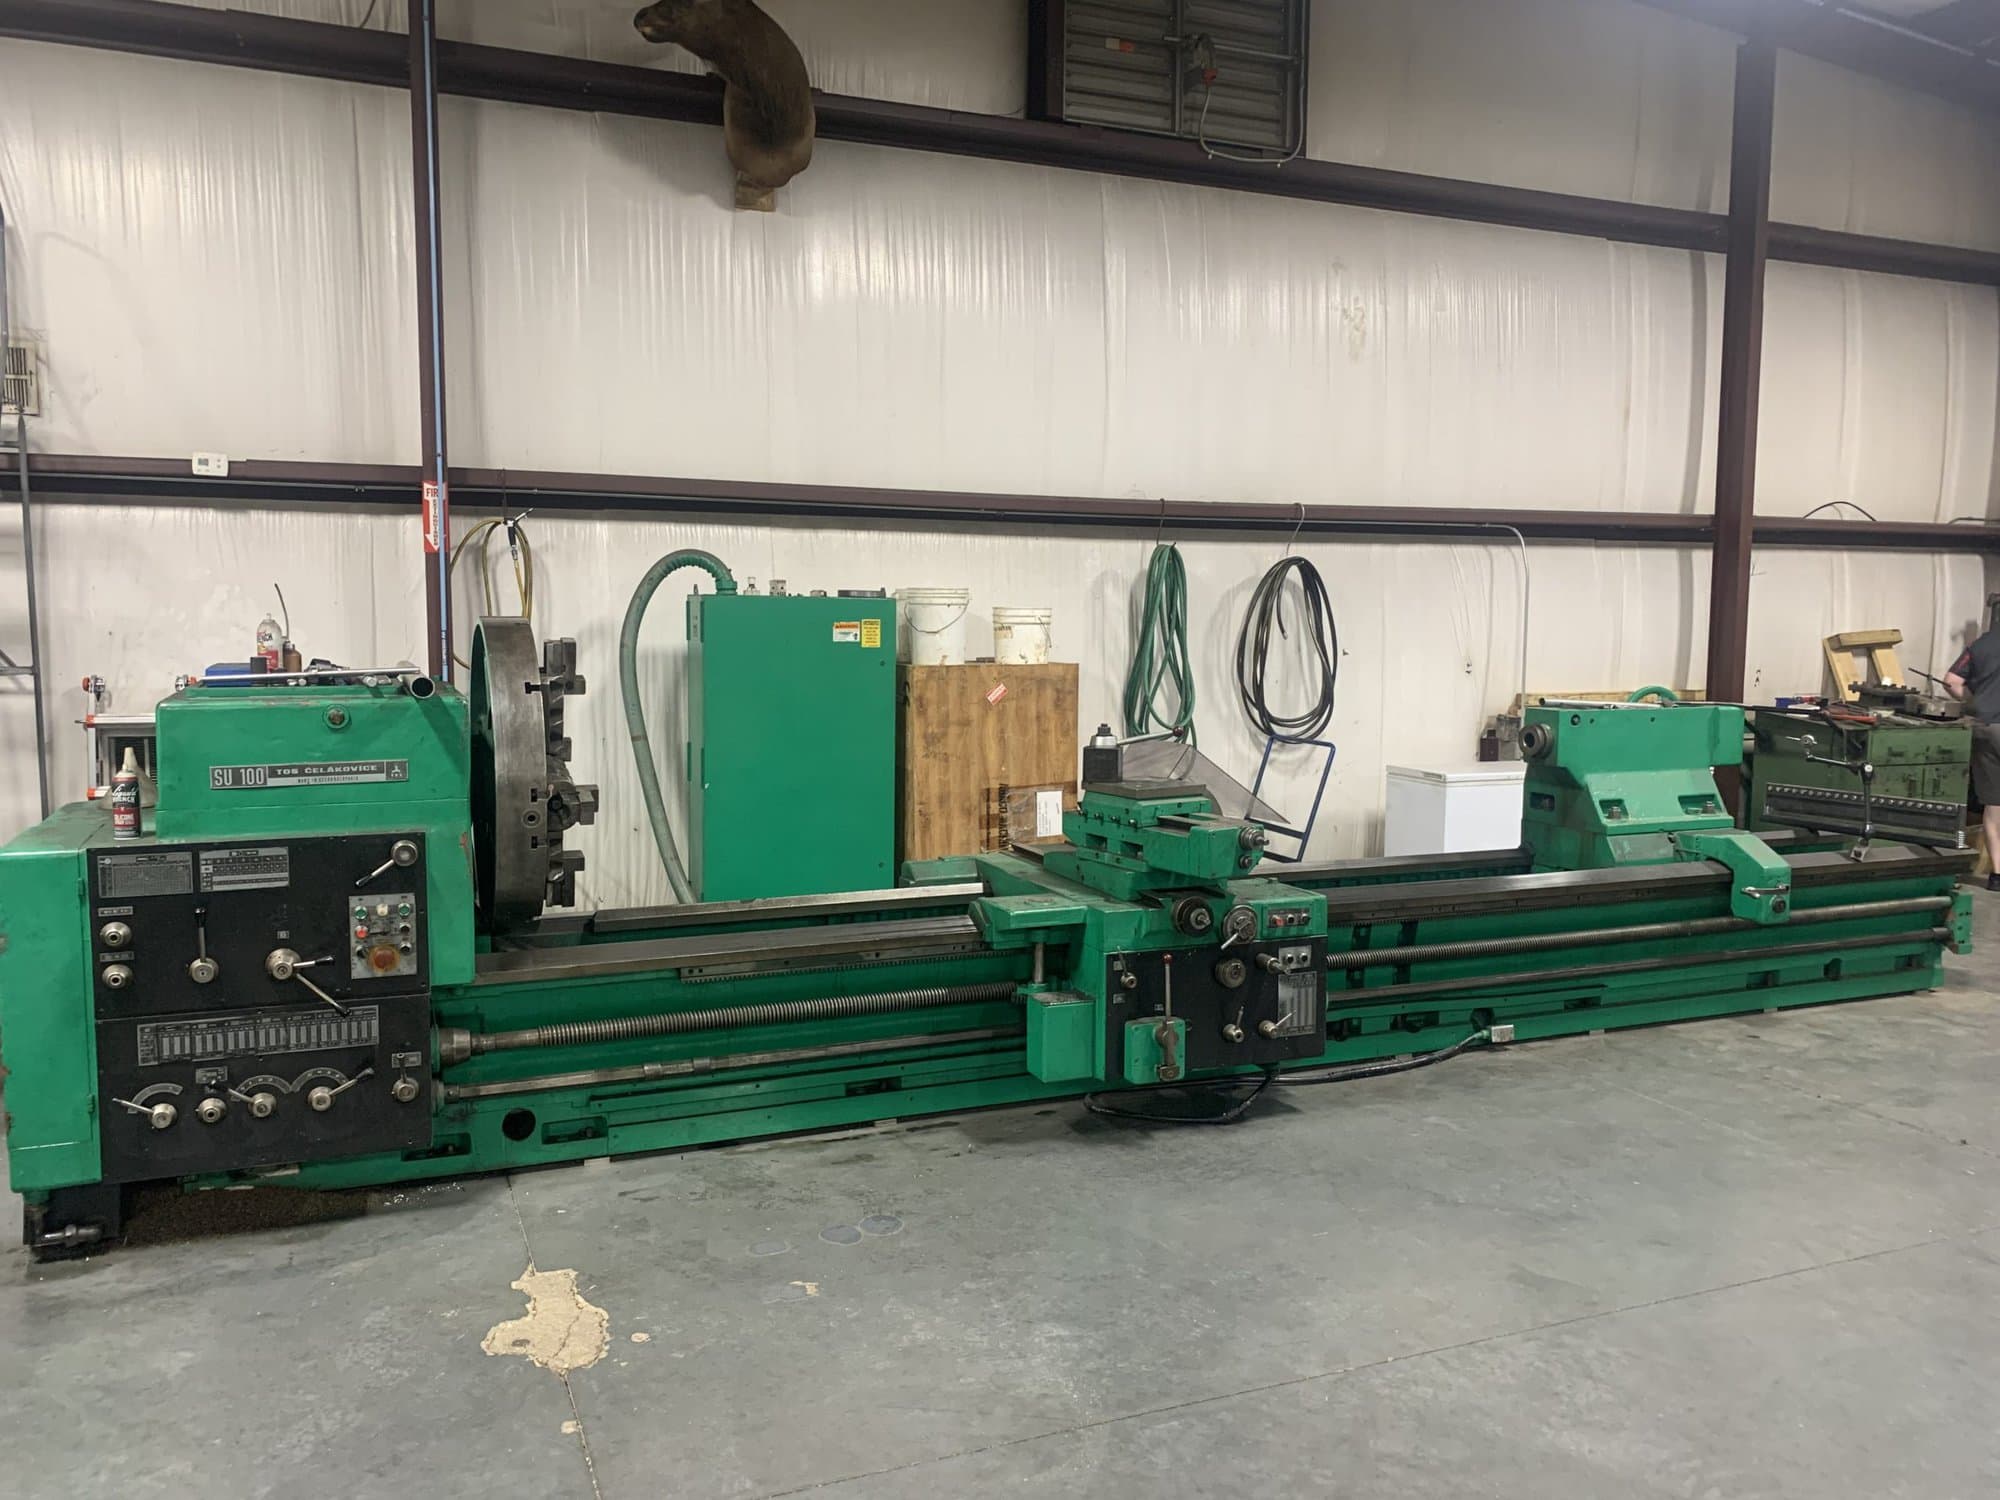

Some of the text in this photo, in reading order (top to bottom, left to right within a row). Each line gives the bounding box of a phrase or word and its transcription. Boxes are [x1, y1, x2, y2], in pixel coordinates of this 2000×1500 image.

[426, 487, 441, 497] FIR
[214, 767, 265, 786] SU 100
